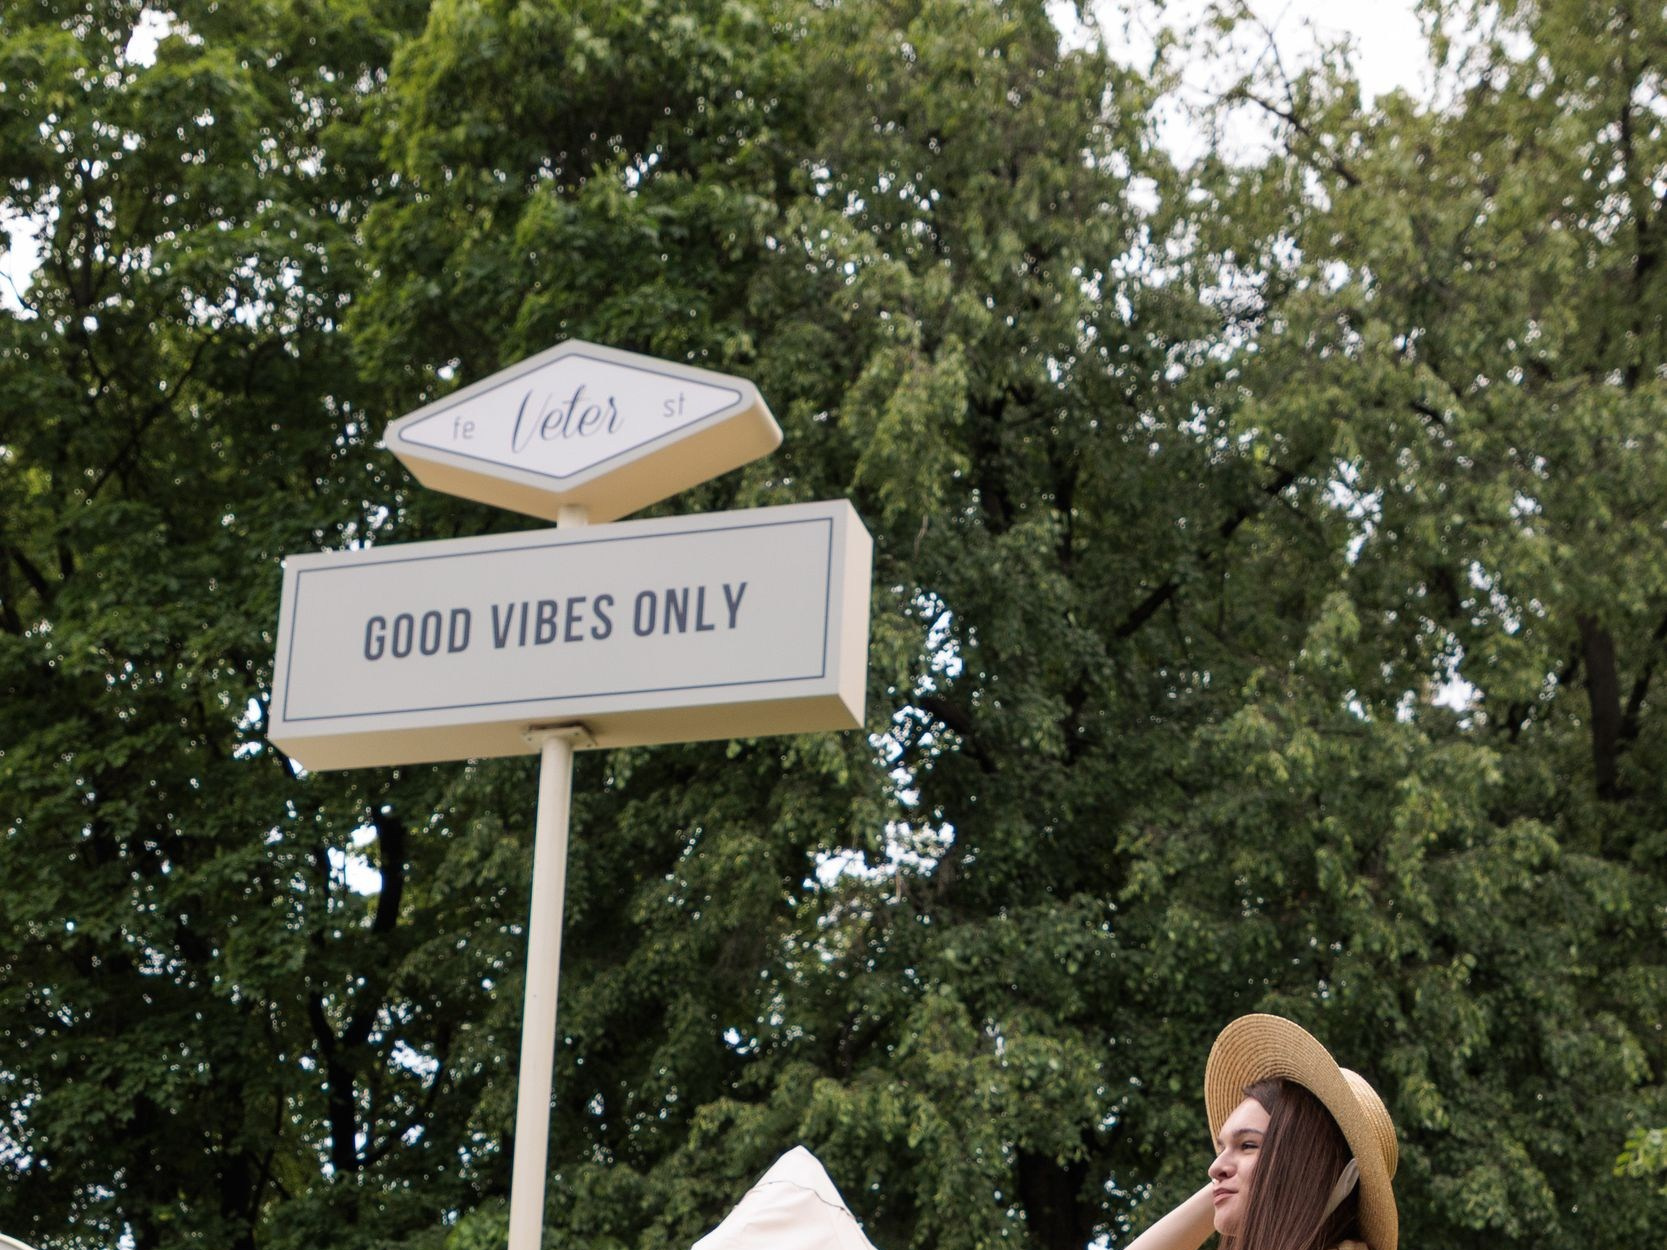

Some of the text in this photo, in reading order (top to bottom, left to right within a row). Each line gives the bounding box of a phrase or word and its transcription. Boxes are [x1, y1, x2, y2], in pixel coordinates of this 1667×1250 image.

[453, 384, 686, 453] fe Veter st
[363, 581, 748, 661] GOOD VIBES ONLY
